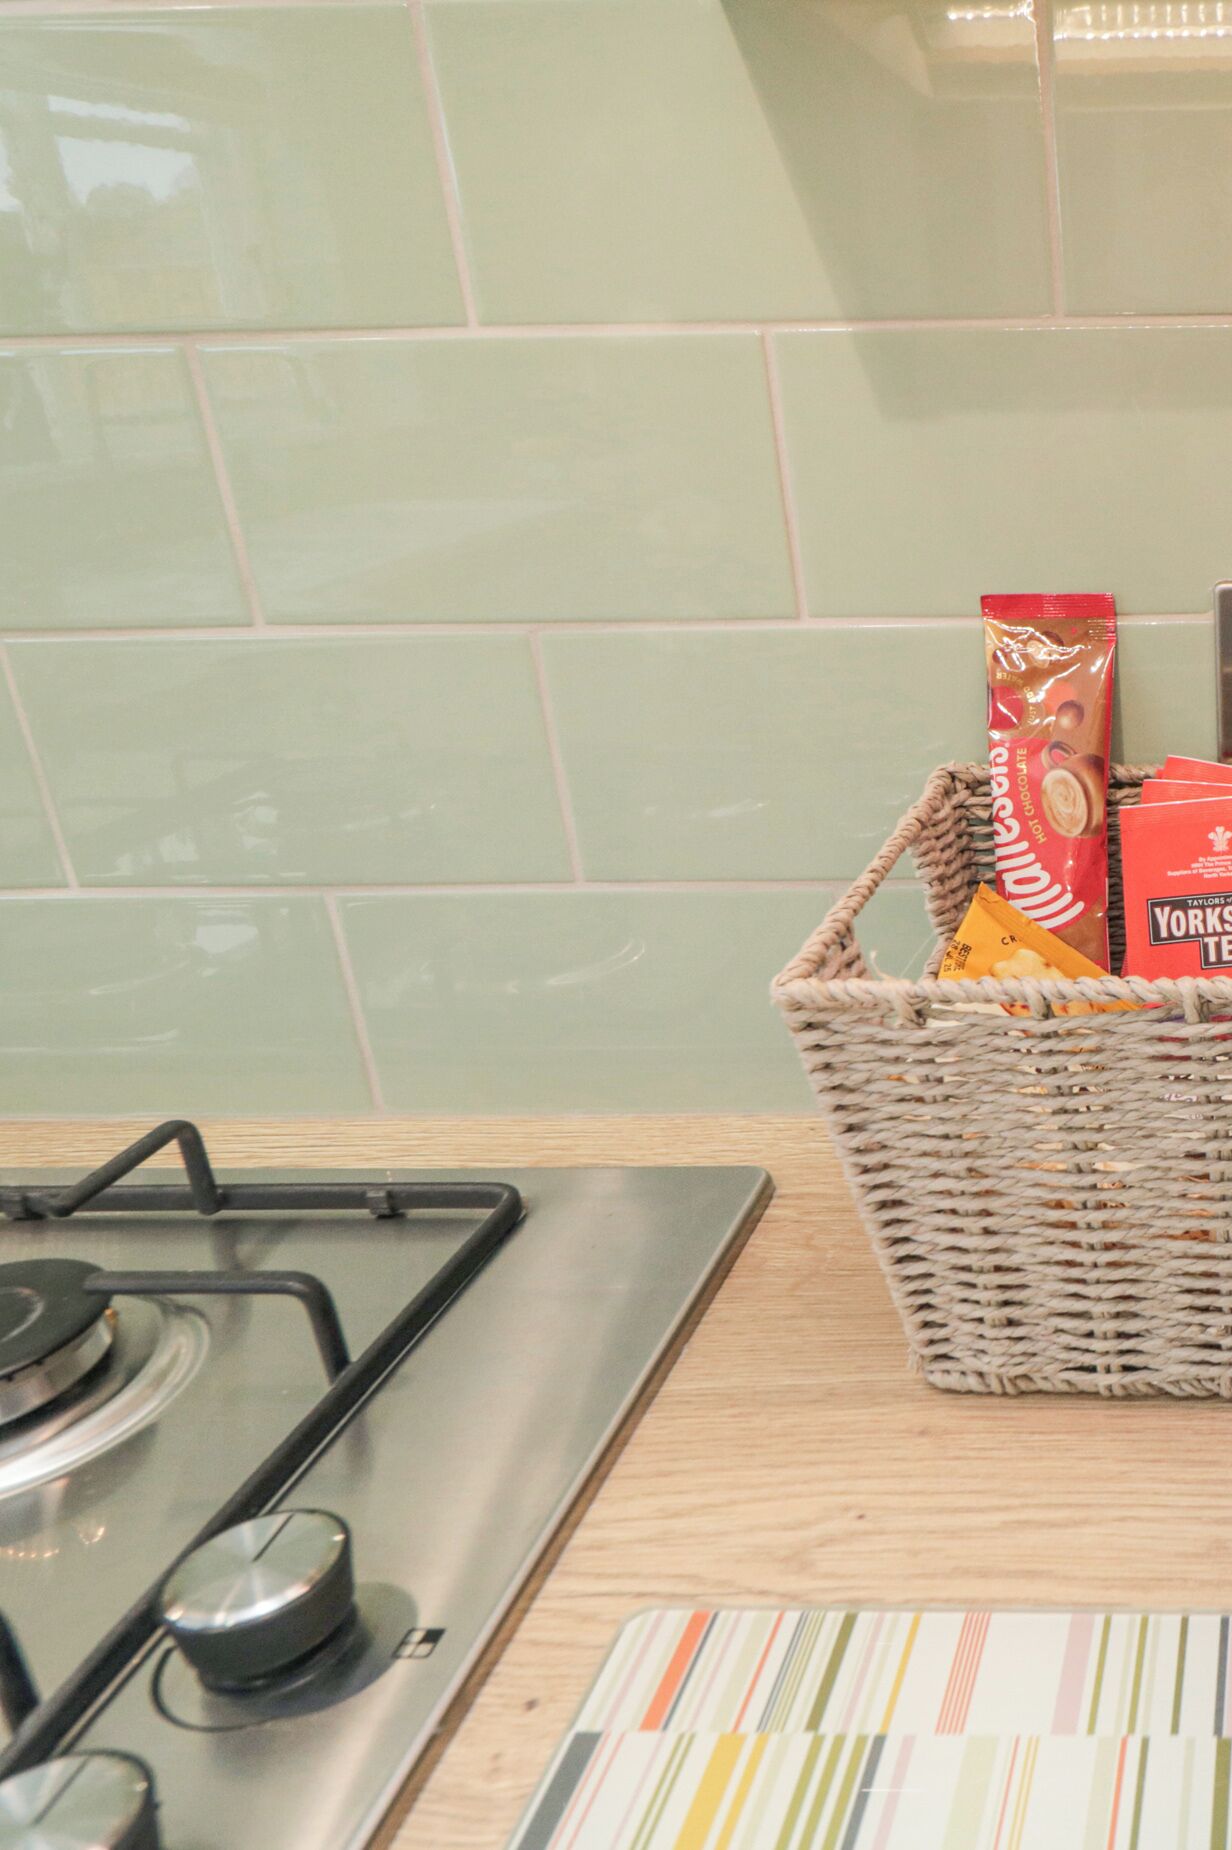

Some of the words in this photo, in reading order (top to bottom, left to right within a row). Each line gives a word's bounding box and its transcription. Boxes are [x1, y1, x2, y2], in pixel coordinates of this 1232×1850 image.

[1016, 747, 1035, 817] CHOCOLATE
[1029, 819, 1048, 845] HOT
[1187, 897, 1225, 907] TAYLORS
